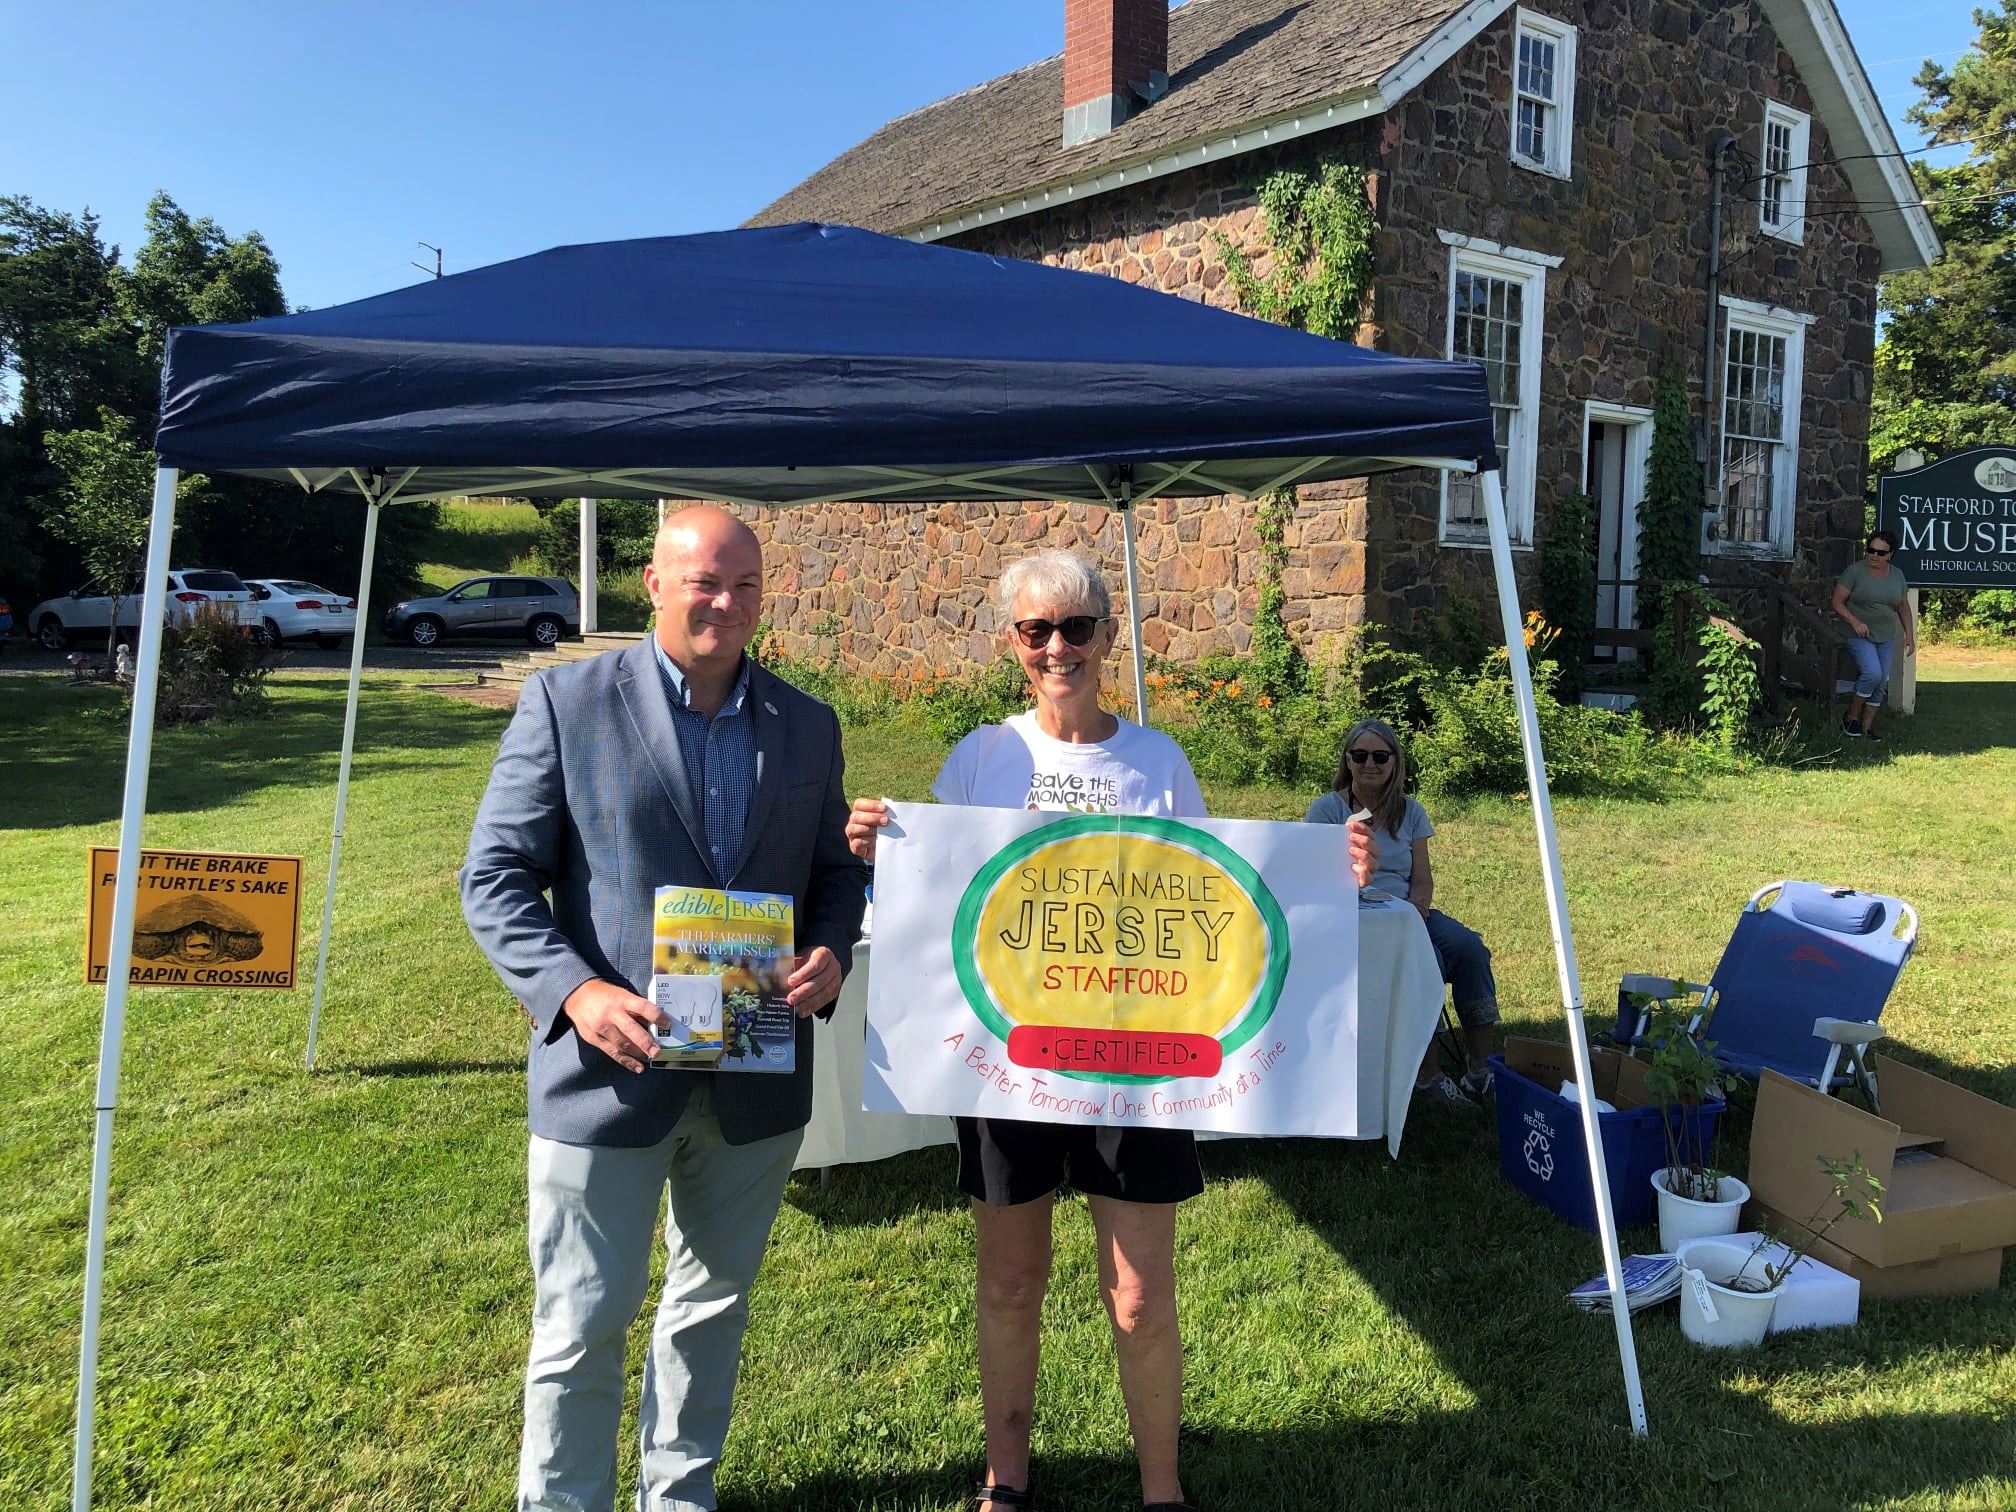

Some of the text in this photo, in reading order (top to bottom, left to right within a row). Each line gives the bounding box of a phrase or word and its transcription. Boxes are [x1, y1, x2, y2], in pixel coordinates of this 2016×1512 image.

[1898, 494, 1995, 516] STAFFORD
[1898, 516, 2016, 554] MUSE
[1920, 559, 1990, 572] HISTORICAL
[139, 855, 269, 875] IT THE BRAKE
[149, 875, 236, 893] TURTLE'S
[240, 880, 289, 895] SAKE
[1020, 866, 1221, 902] SUSTAINABLE
[677, 929, 708, 942] THE
[999, 899, 1235, 962] JERSEY
[676, 942, 776, 959] MARKET ISSUE
[93, 965, 289, 985] TRAPIN CROSSING
[1042, 964, 1188, 997] STAFFORD
[943, 1032, 965, 1052] A
[1055, 1038, 1189, 1065] CERTIFIED
[1250, 1040, 1286, 1072] Time
[965, 1046, 1022, 1096] Better
[1249, 1071, 1261, 1086] a
[1236, 1073, 1250, 1095] at
[1112, 1092, 1148, 1118] One
[1152, 1083, 1233, 1116] Community
[1523, 1113, 1556, 1138] RECYCLE
[1533, 1108, 1546, 1123] WE
